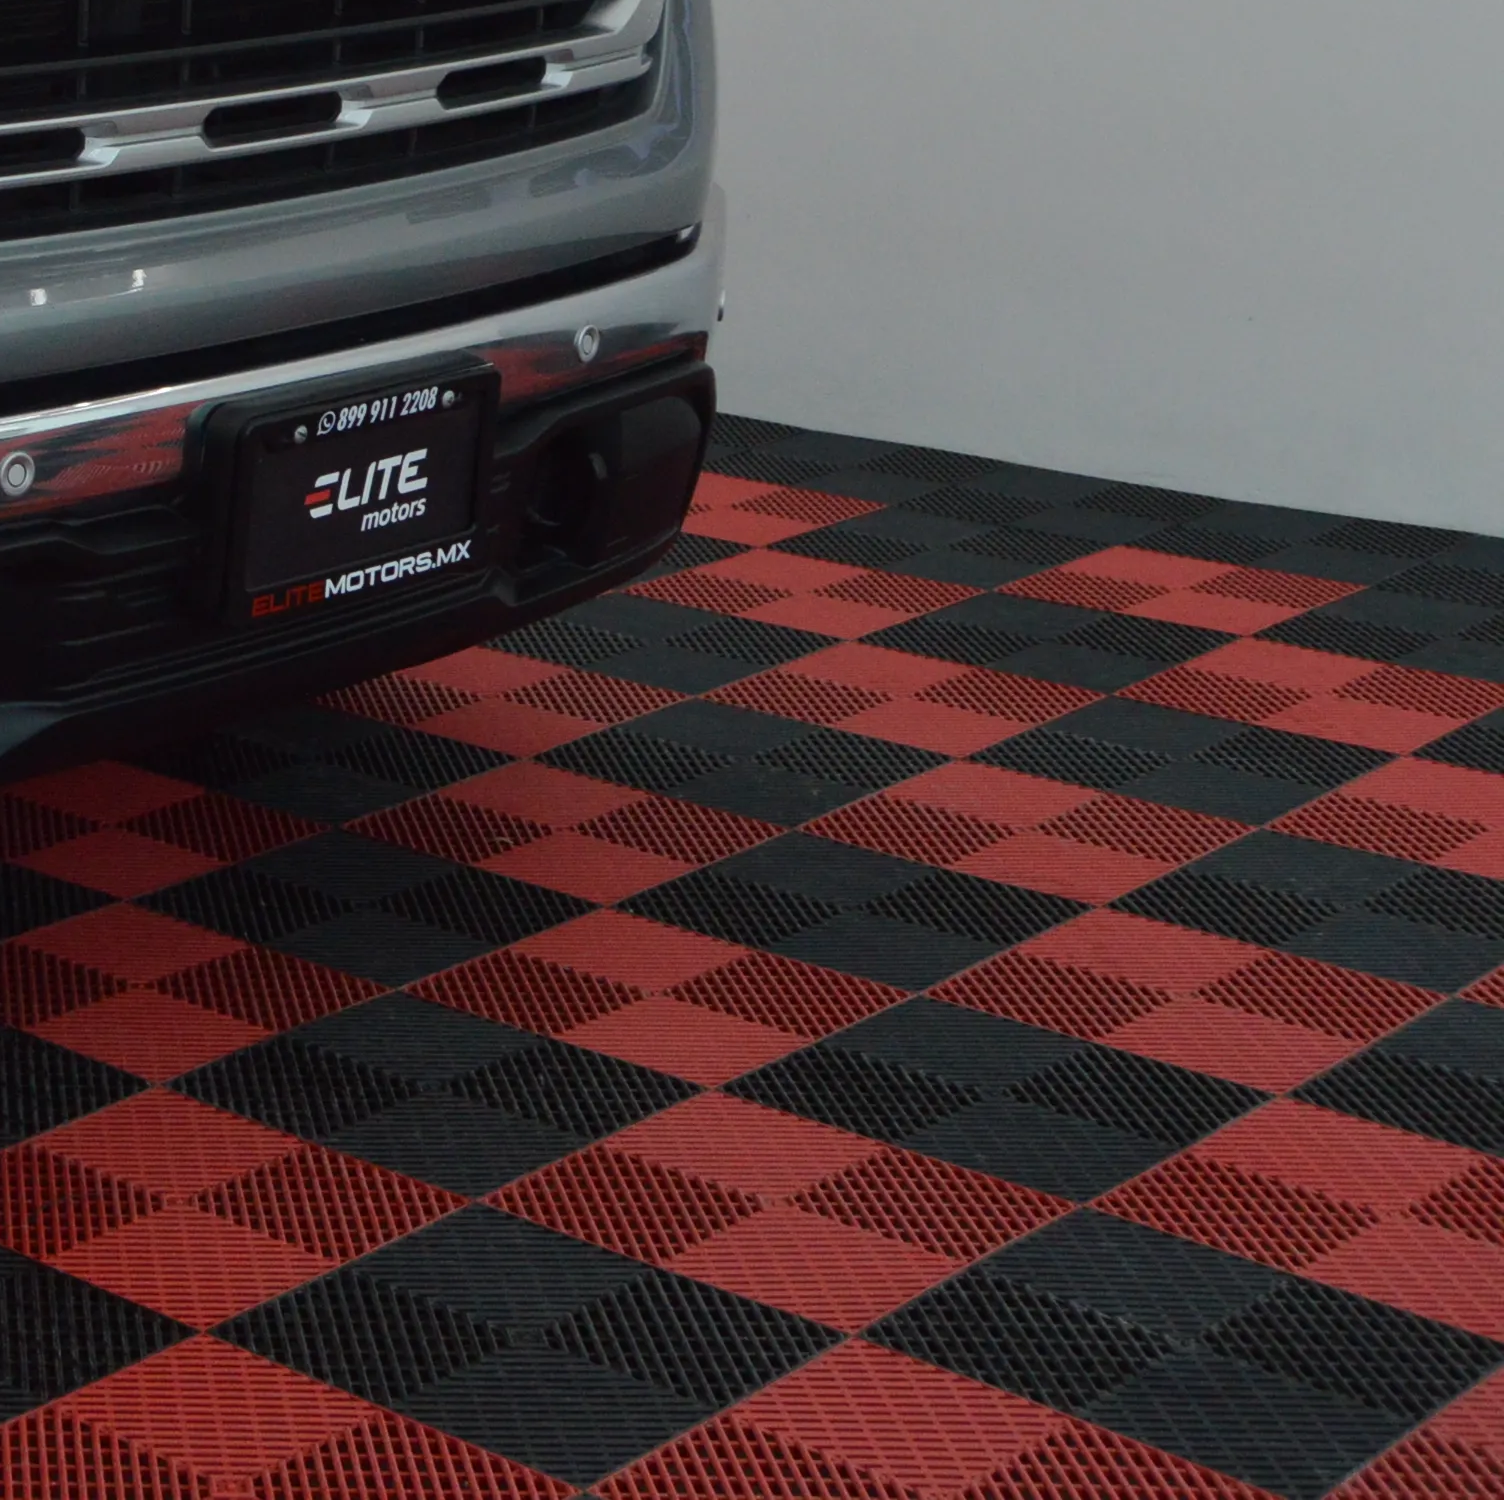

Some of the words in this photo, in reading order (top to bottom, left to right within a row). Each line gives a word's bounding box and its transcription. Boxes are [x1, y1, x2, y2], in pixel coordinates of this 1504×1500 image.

[337, 404, 366, 431] 899
[371, 396, 397, 422] 911
[400, 386, 438, 417] 2208
[304, 448, 428, 519] ELITE
[361, 498, 426, 532] motors
[252, 540, 472, 617] ELITEMOTORS.MX
